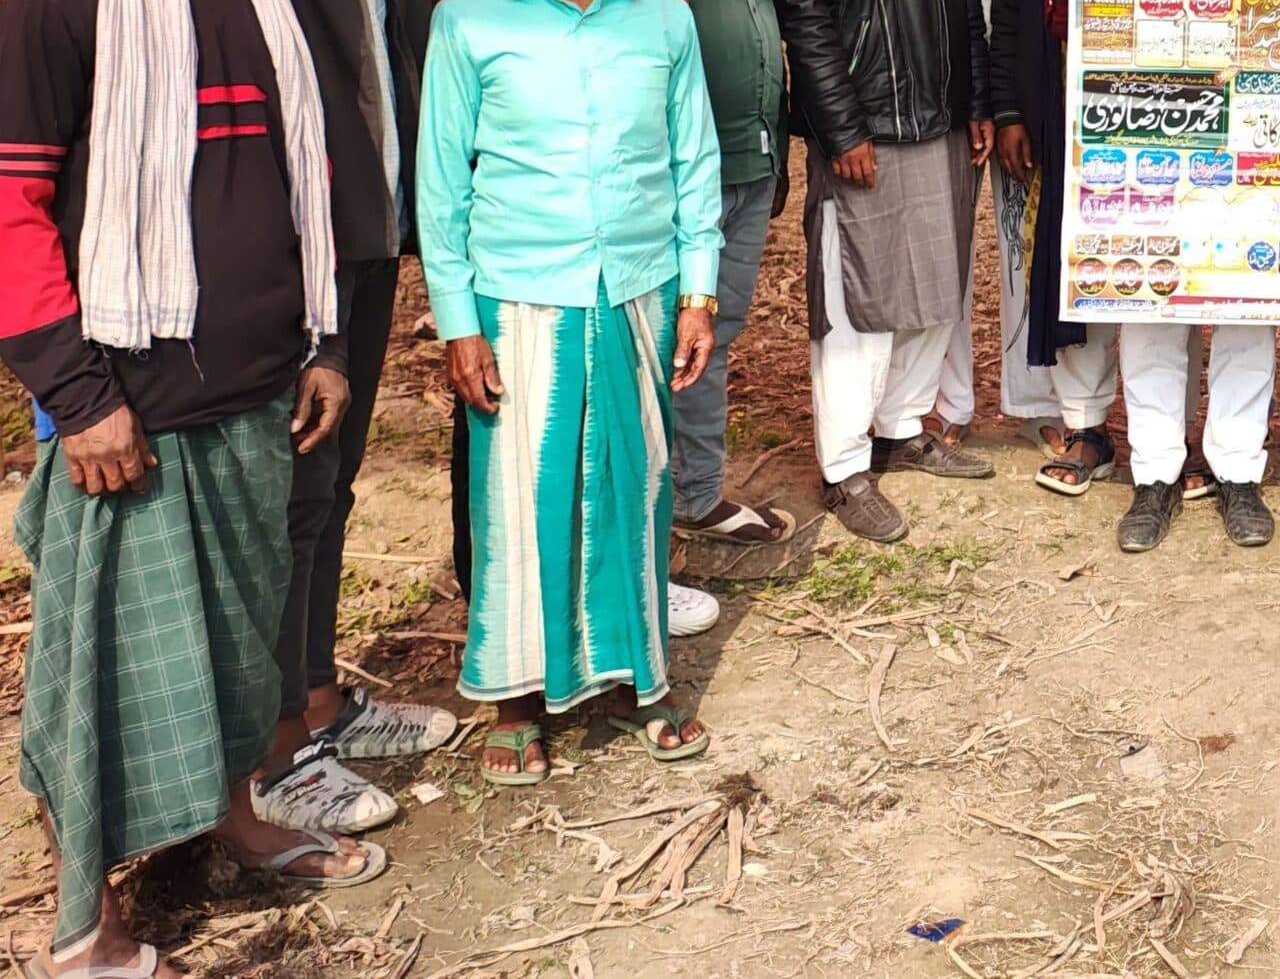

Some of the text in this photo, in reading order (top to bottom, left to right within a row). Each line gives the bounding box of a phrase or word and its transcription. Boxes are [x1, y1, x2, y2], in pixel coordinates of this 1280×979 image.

[1083, 90, 1224, 136] محمد حسن رضا نوری
